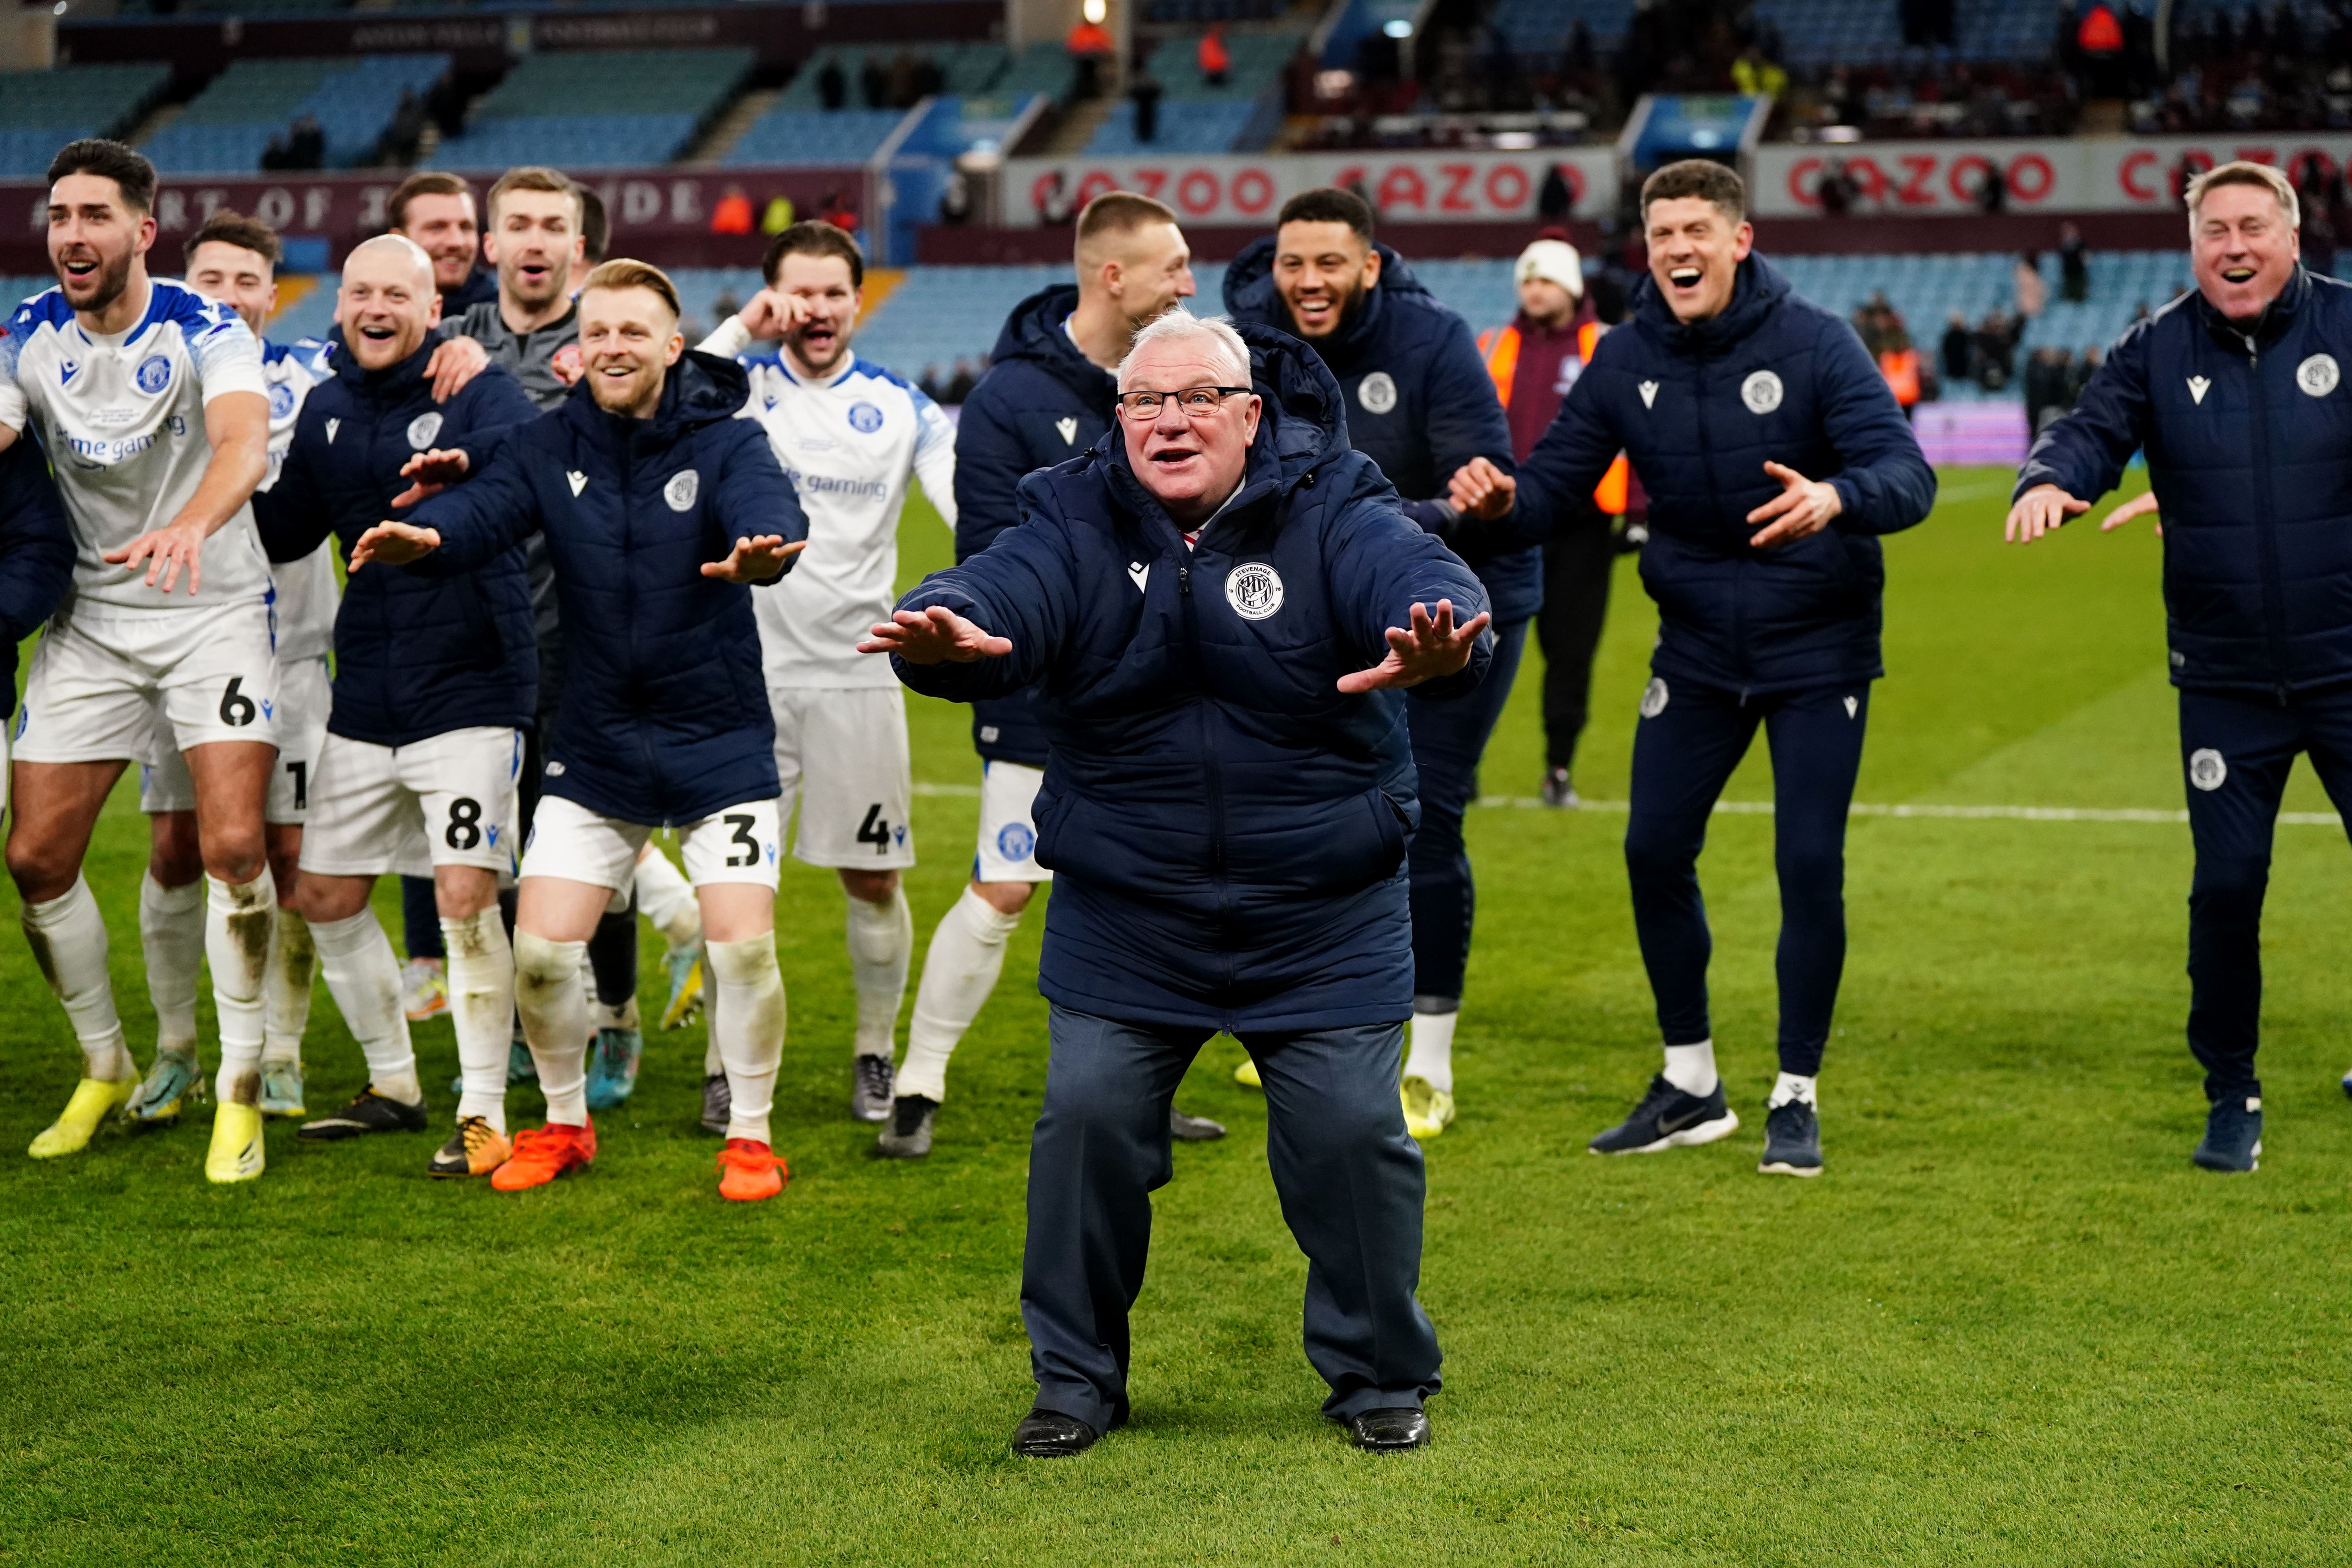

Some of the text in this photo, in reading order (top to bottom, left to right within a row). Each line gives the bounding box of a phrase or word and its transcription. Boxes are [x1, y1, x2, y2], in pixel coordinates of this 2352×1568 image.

[807, 474, 887, 502] gaming
[1235, 566, 1272, 577] STEVENAGE
[1236, 603, 1275, 615] FOOTBALL CLUB
[219, 676, 256, 727] 6
[445, 797, 481, 850] 8
[724, 814, 760, 867] 3
[856, 803, 890, 855] 4
